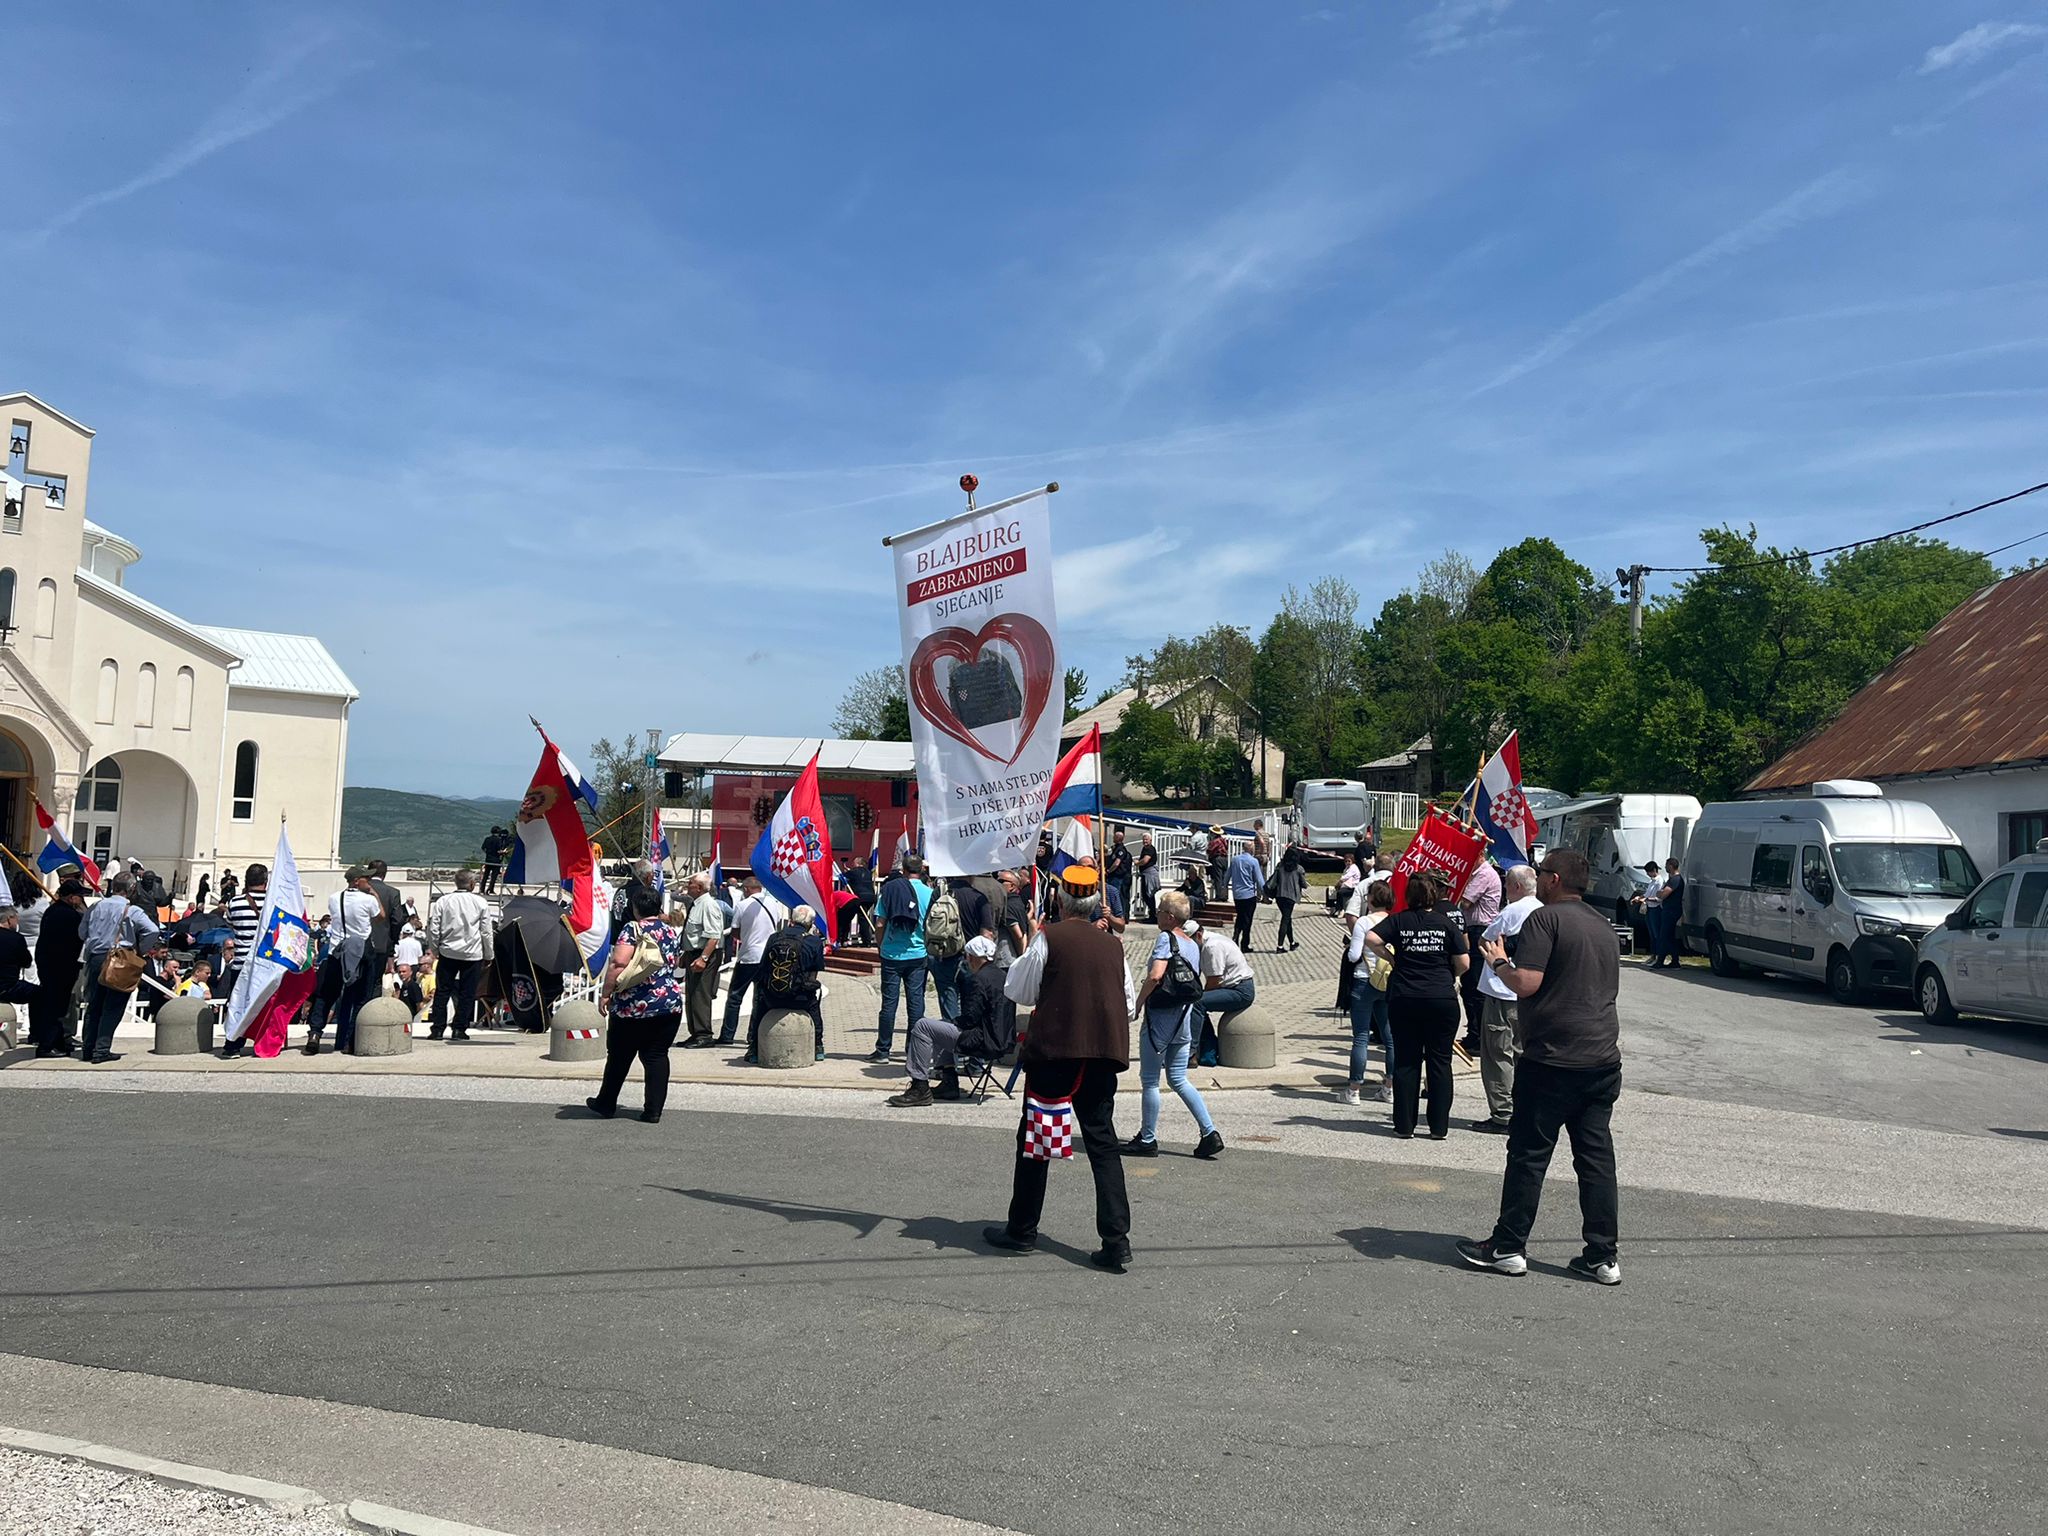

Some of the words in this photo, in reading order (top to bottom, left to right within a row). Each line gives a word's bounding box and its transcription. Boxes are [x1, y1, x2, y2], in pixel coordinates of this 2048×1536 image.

[917, 521, 1021, 574] BLAJBURG
[919, 555, 1015, 598] ZABRANJENO
[935, 583, 1004, 618] SJEĆANJE
[955, 787, 965, 800] S
[968, 780, 1005, 798] NAMA
[1005, 775, 1029, 791] STE
[972, 798, 1003, 816] DIŠE
[1004, 798, 1009, 810] I
[958, 815, 1023, 839] HRVATSKI
[1025, 810, 1045, 825] KA
